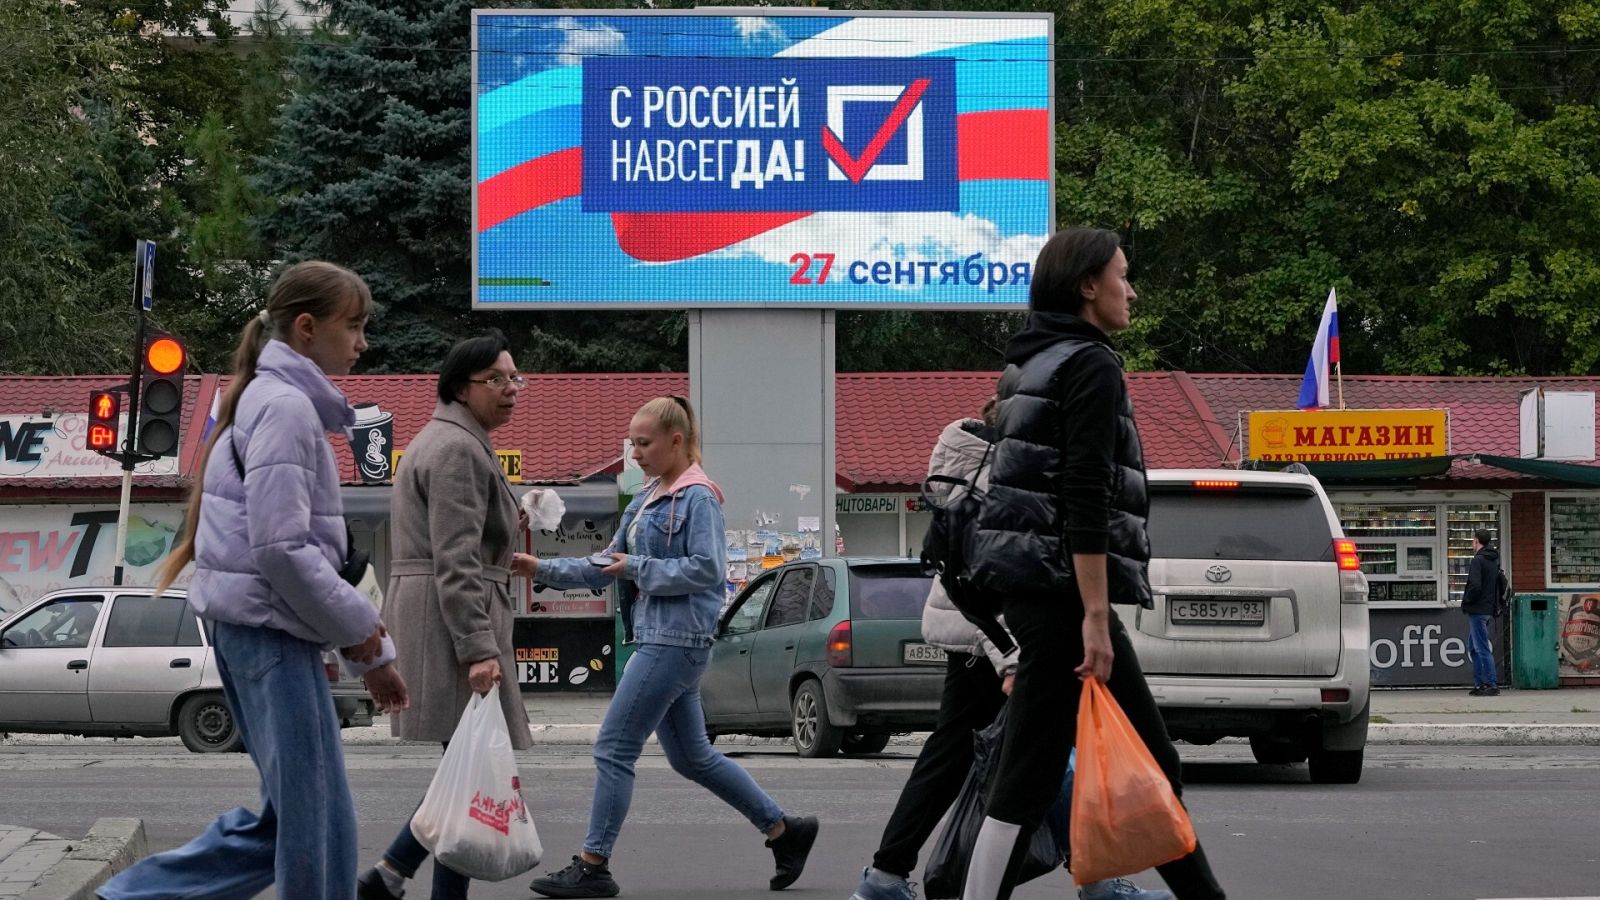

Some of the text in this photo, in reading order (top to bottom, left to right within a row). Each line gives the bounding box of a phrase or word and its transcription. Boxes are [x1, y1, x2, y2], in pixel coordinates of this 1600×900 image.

[611, 78, 800, 128] С РОССИЕЙ
[612, 140, 805, 189] НАВСЕГДА!
[790, 252, 1031, 294] 27 сентября
[92, 427, 113, 445] 64
[1293, 425, 1435, 447] МАГАЗИН
[1243, 603, 1258, 615] 93
[1370, 624, 1493, 668] offe
